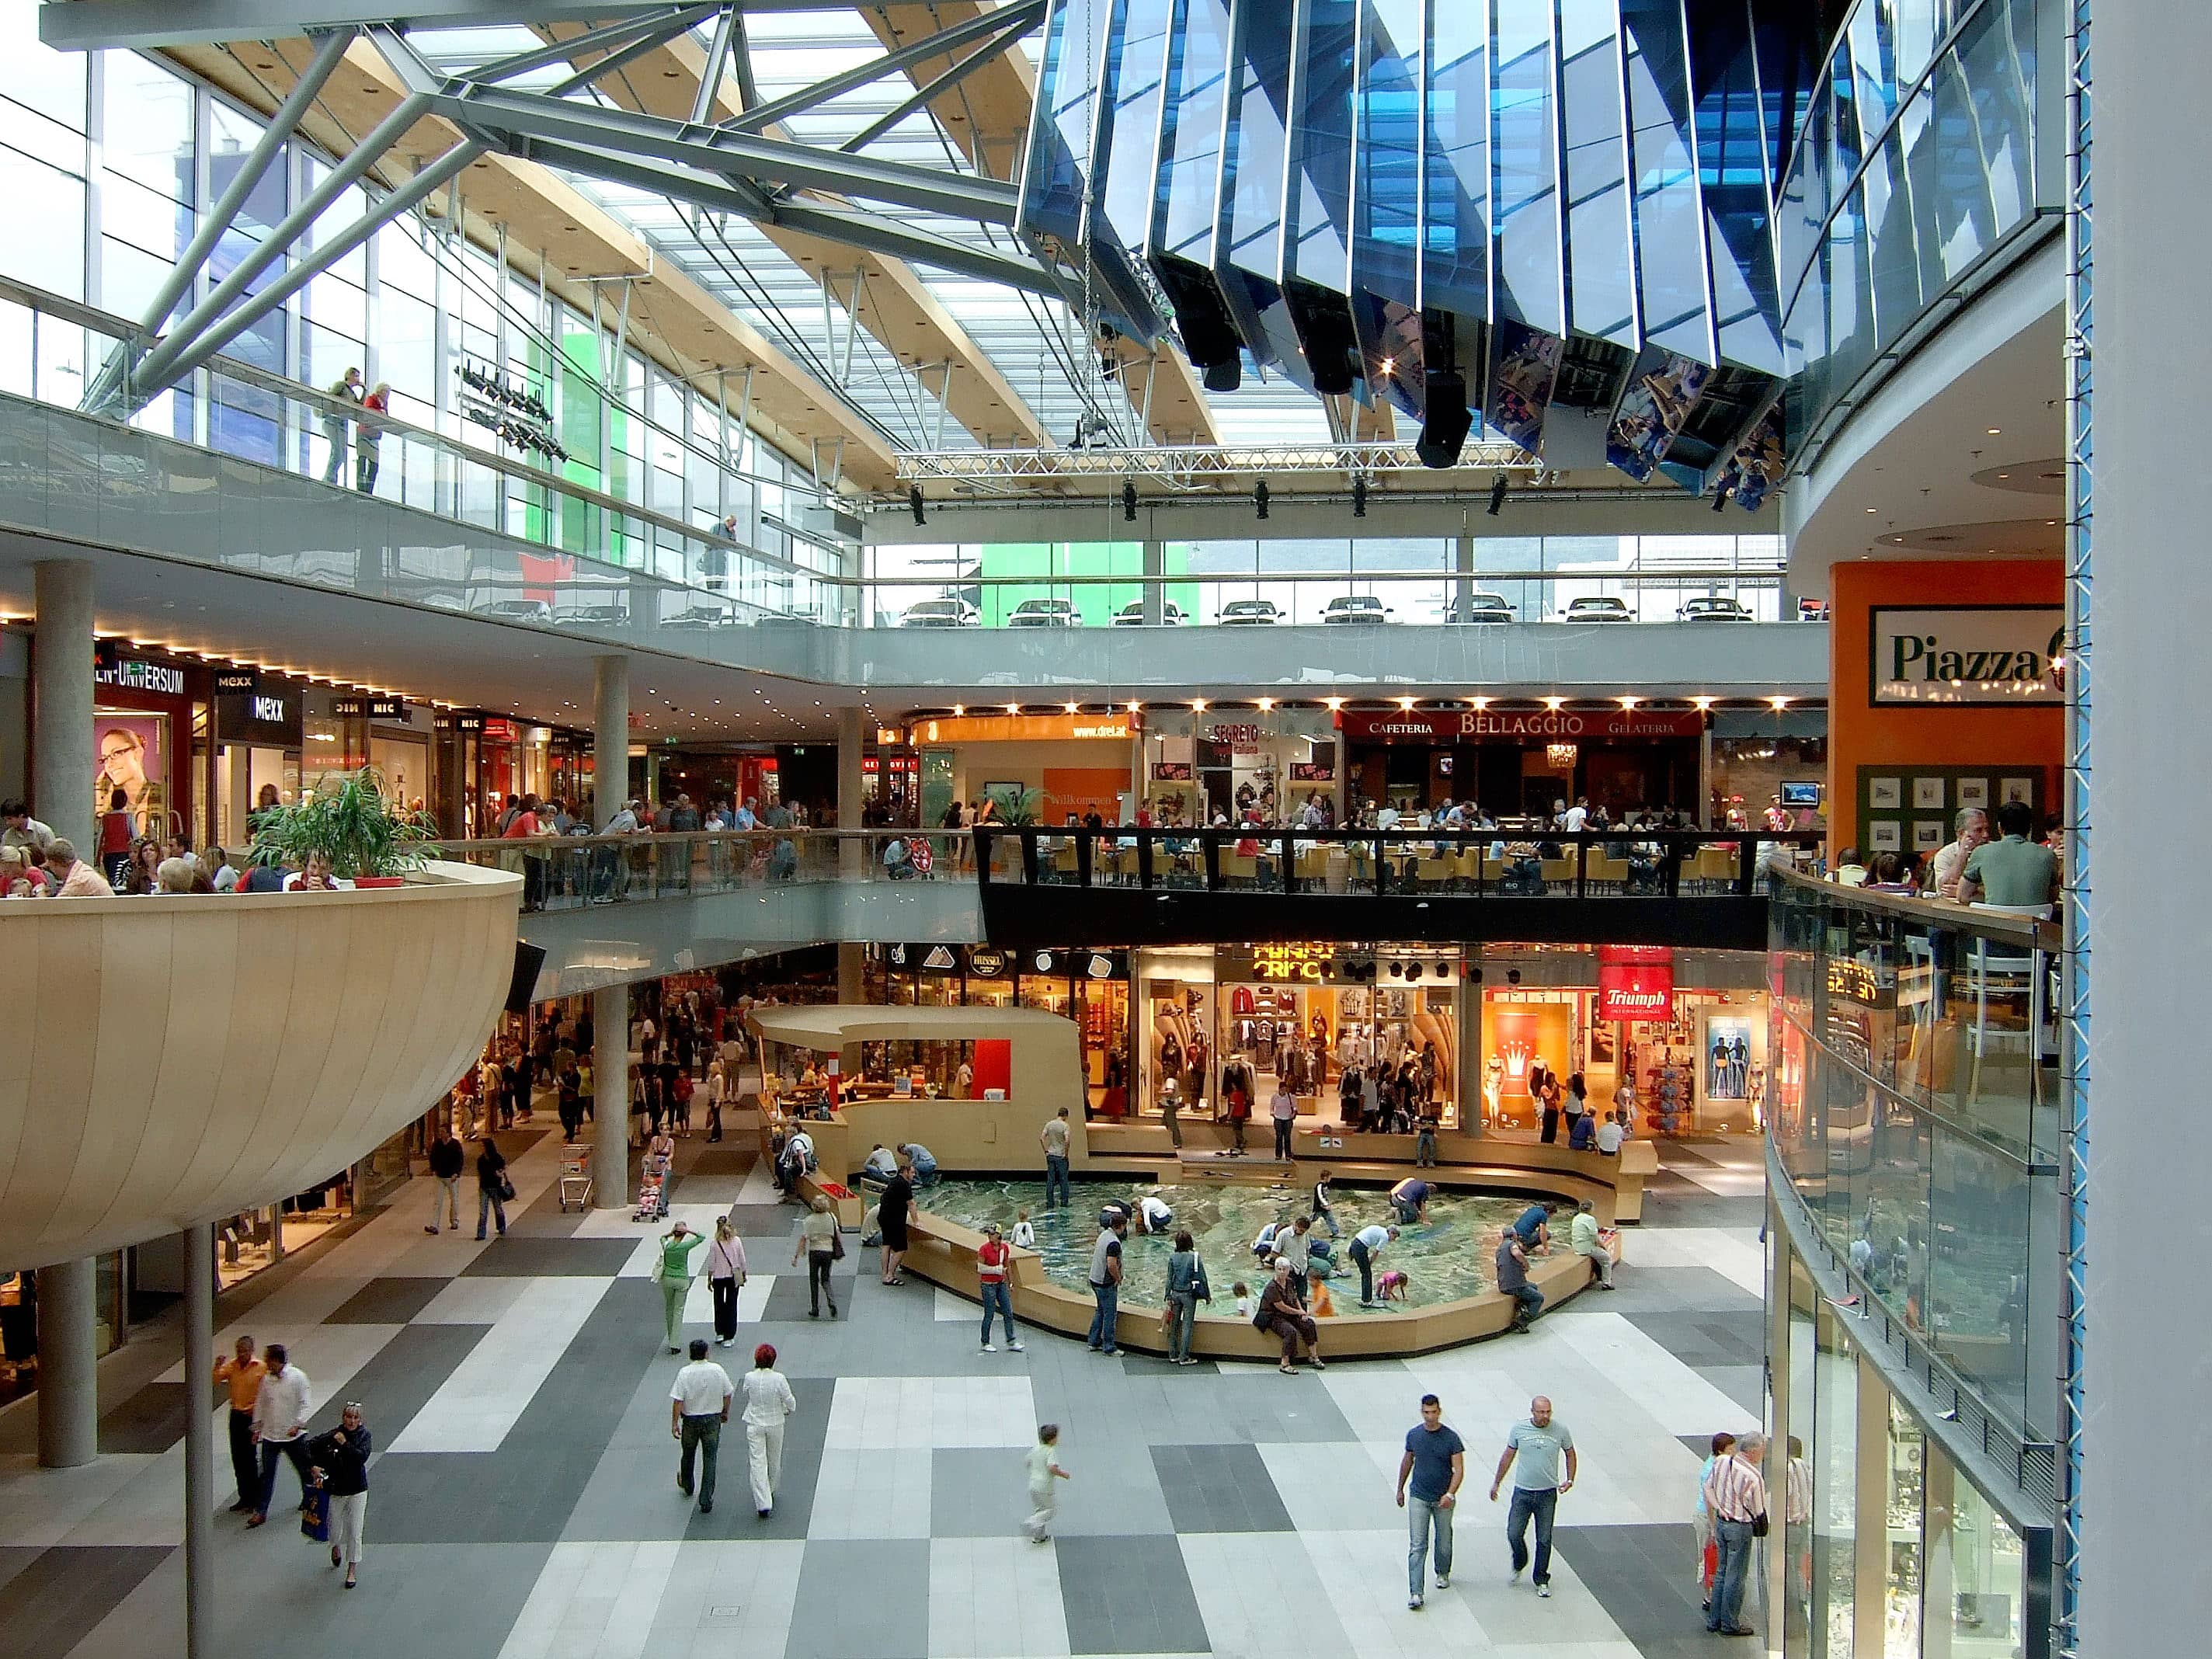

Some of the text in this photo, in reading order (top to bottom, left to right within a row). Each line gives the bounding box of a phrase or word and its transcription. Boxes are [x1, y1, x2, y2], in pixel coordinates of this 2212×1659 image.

[1889, 635, 2043, 682] Piazza
[1214, 725, 1258, 743] SEGRETO
[1369, 722, 1433, 733] CAFETERIA
[1460, 714, 1584, 734] BELLAGGIO
[1254, 960, 1335, 979] CRIC
[1606, 989, 1666, 1009] Triumph
